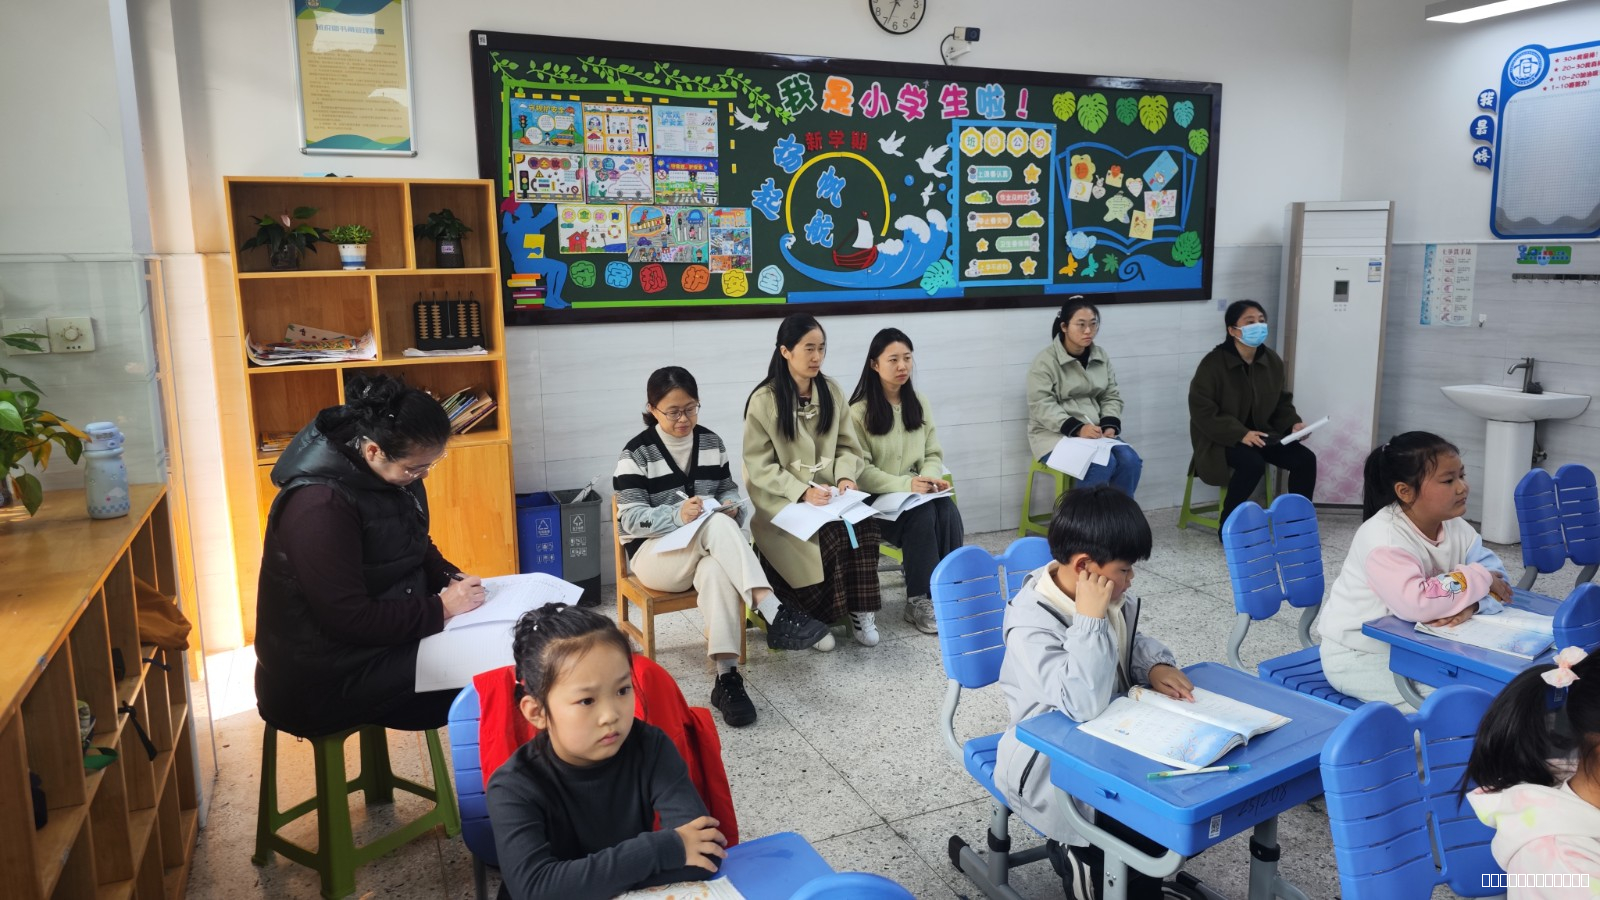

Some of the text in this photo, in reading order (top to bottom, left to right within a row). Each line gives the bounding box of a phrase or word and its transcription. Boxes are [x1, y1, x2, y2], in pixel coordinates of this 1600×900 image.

[913, 0, 919, 9] 3
[875, 7, 882, 16] 8
[910, 12, 916, 20] 4
[883, 17, 888, 25] 7
[892, 21, 898, 30] 6
[903, 19, 908, 28] 5
[805, 130, 868, 151] 新学期
[965, 133, 1047, 151] 班级公约
